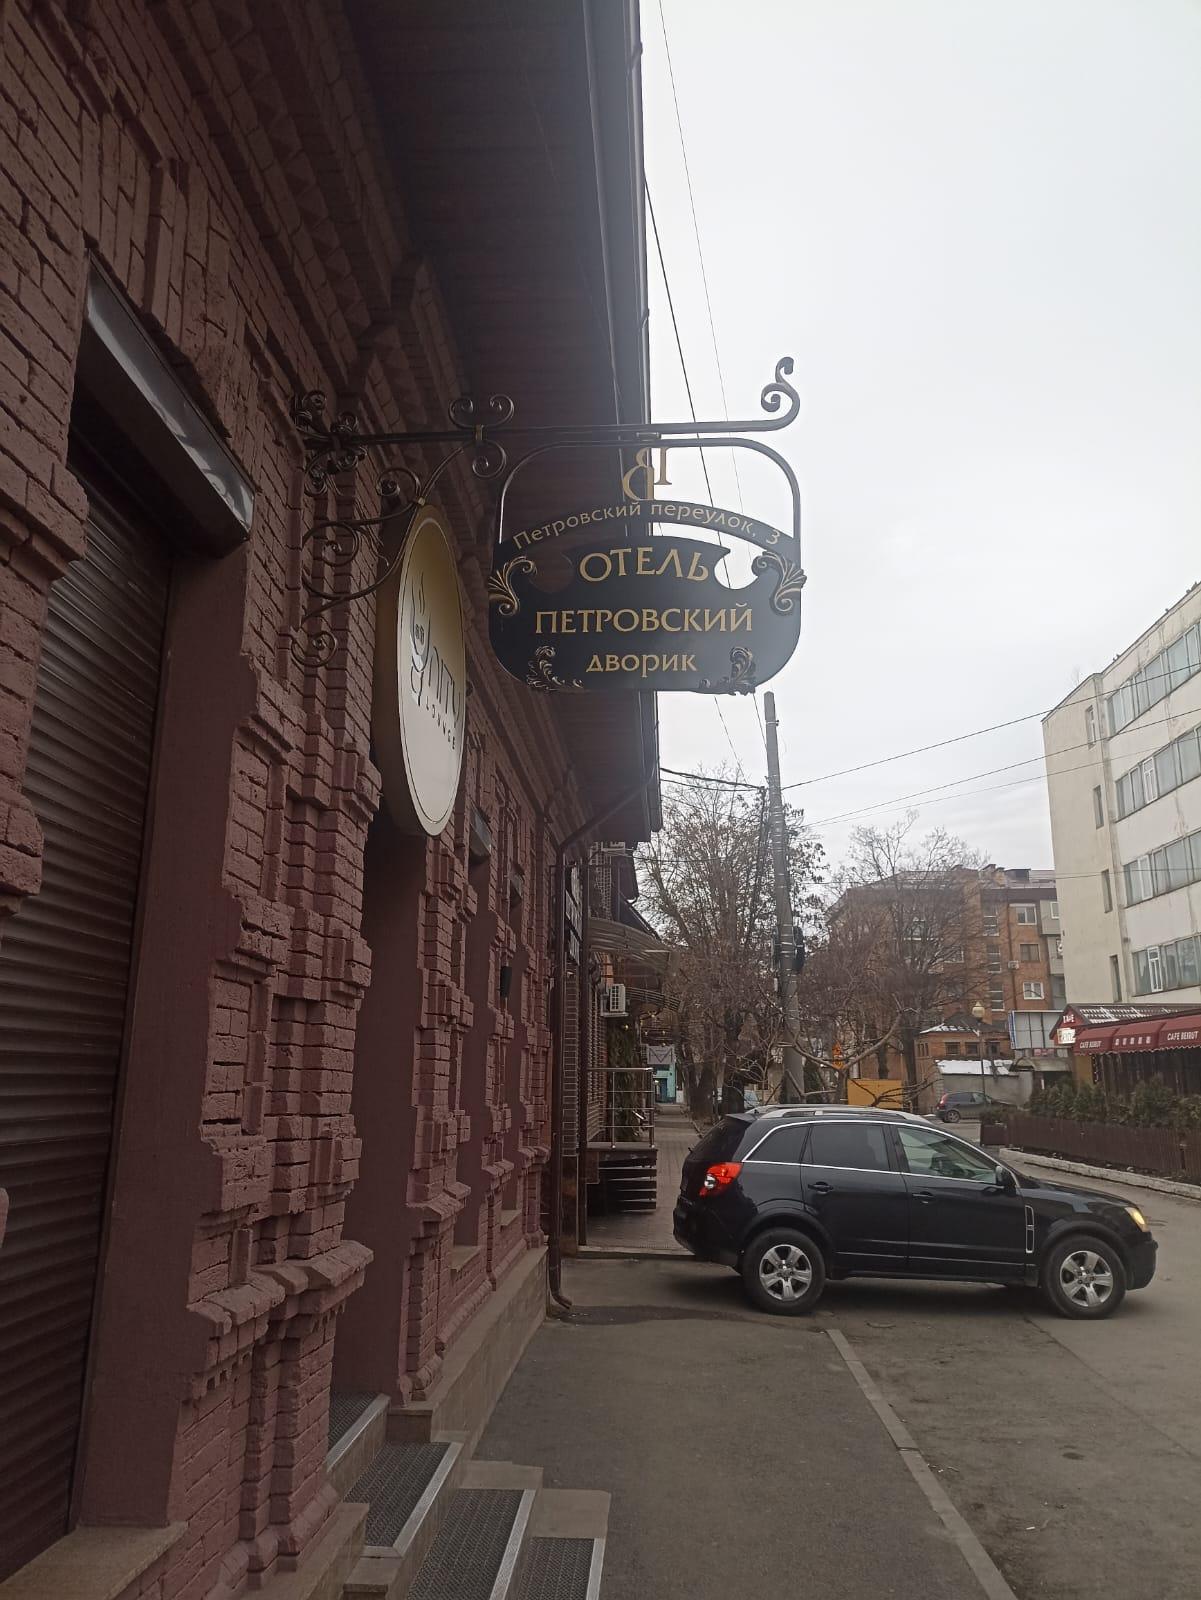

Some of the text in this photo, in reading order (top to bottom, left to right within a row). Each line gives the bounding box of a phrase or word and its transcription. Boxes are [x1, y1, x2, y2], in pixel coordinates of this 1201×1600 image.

[512, 501, 781, 550] Петровский переулок, 3
[578, 547, 710, 582] ОТЕЛЬ
[535, 602, 753, 634] ПЕТРОВСКИЙ
